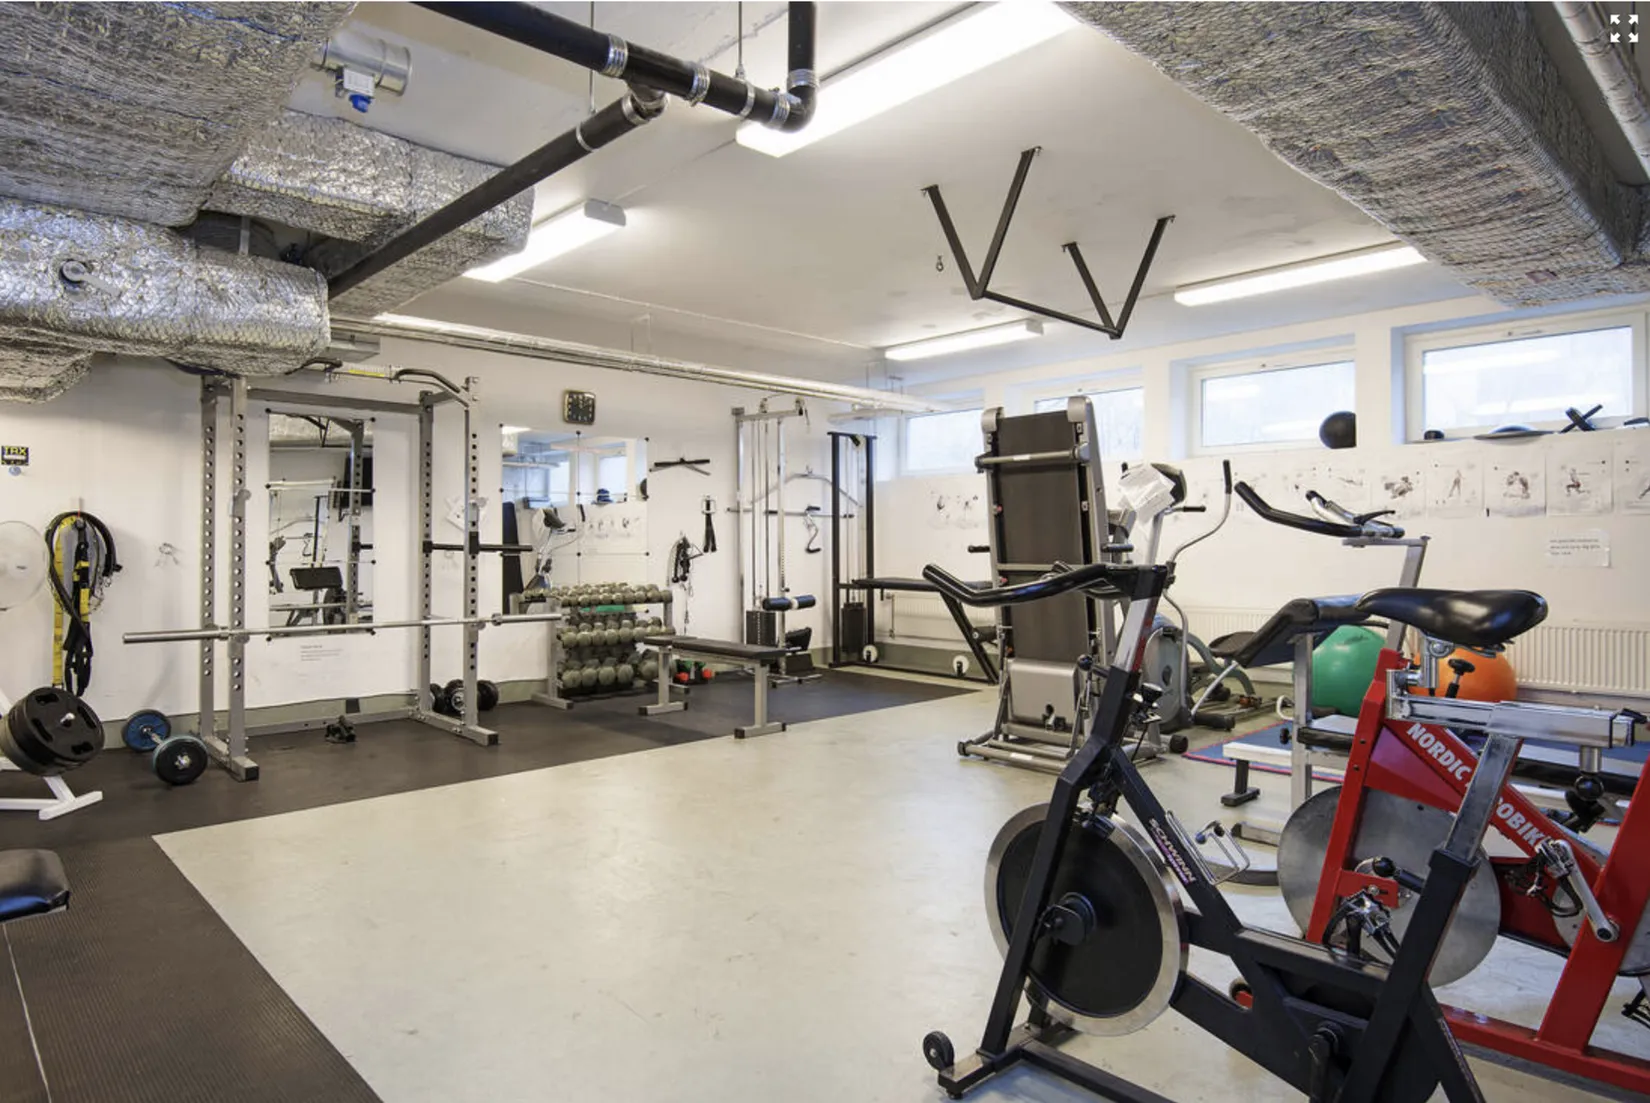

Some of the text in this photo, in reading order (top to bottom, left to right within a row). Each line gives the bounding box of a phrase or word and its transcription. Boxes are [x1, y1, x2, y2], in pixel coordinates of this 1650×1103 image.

[5, 445, 27, 456] TRX
[1406, 723, 1472, 780] NORDIC
[1149, 818, 1197, 882] SCHWINN
